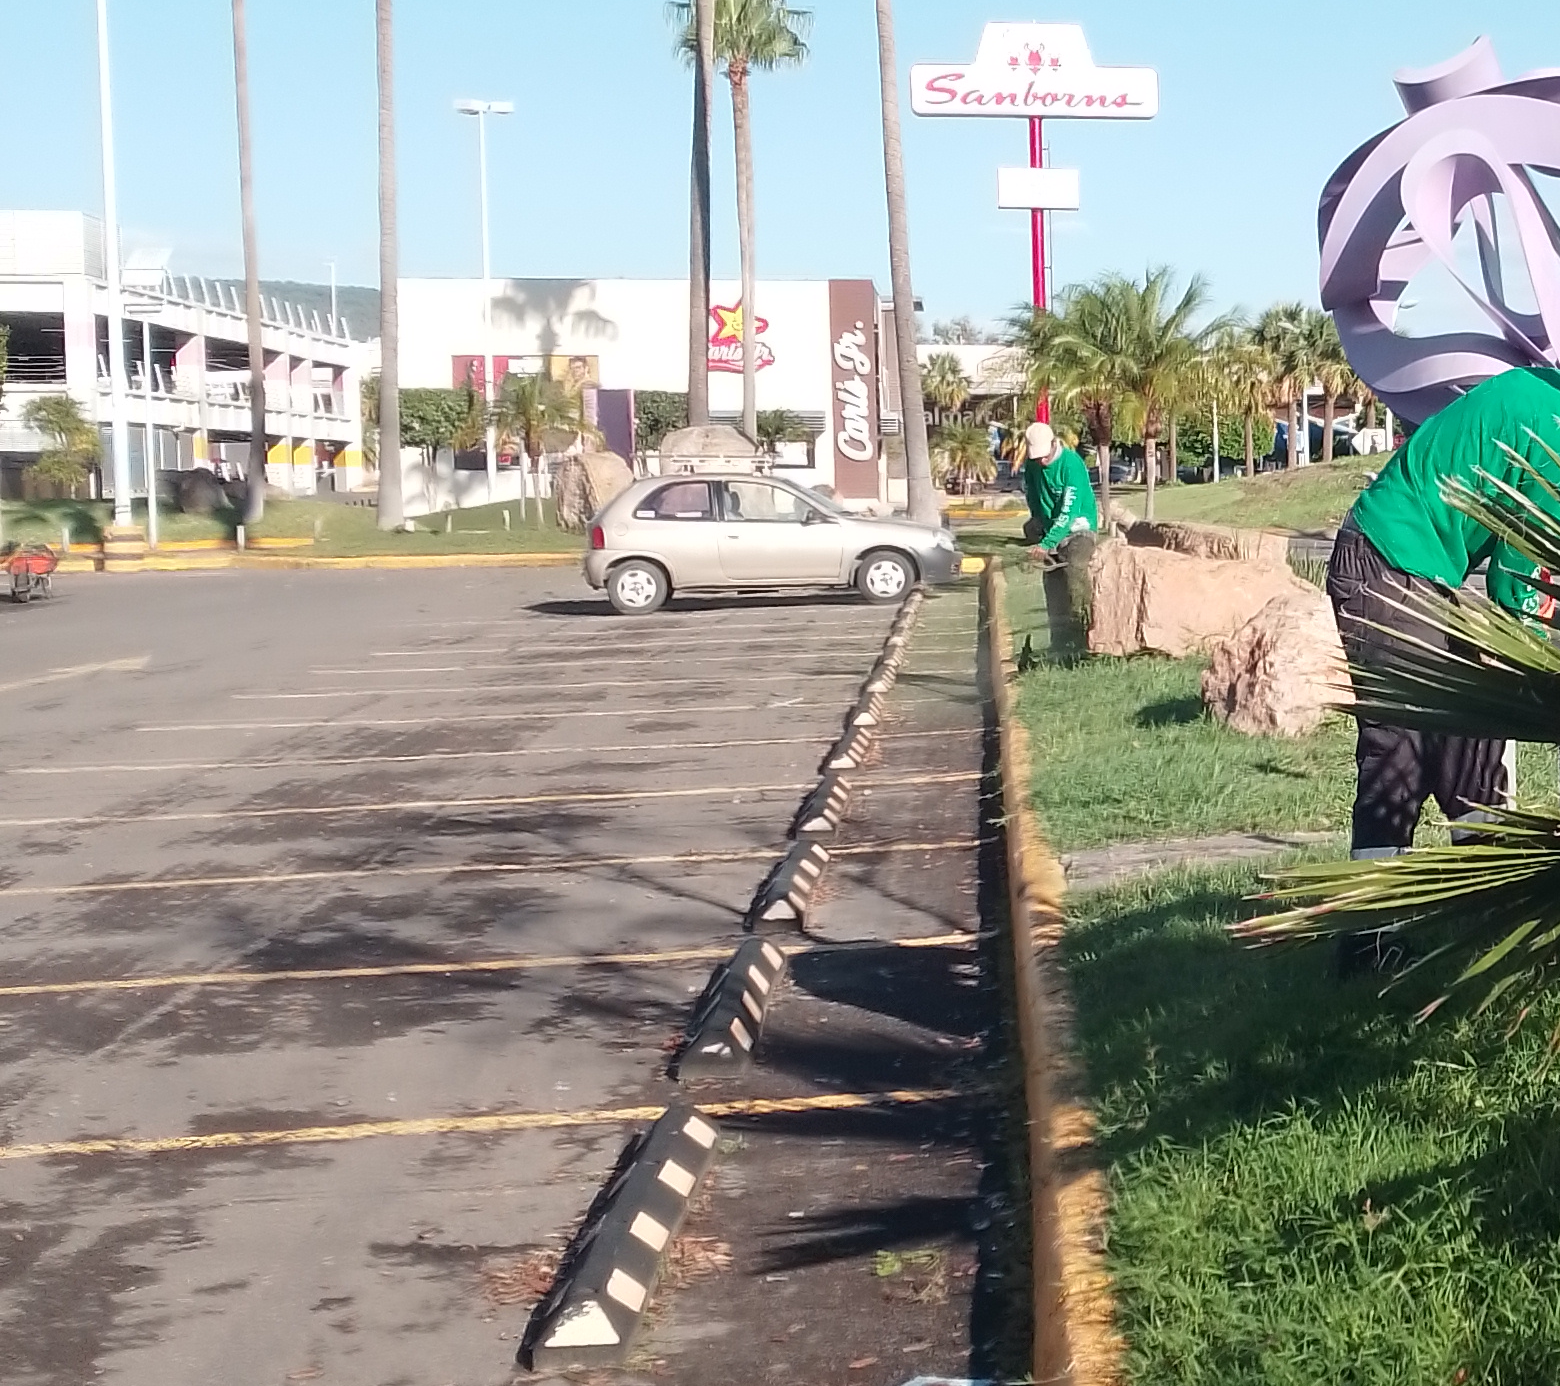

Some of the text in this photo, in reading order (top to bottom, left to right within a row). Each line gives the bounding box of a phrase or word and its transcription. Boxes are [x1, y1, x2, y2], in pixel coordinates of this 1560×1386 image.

[925, 72, 1144, 108] Sanborns
[833, 320, 874, 462] Carl's Jr.
[923, 406, 992, 426] almart
